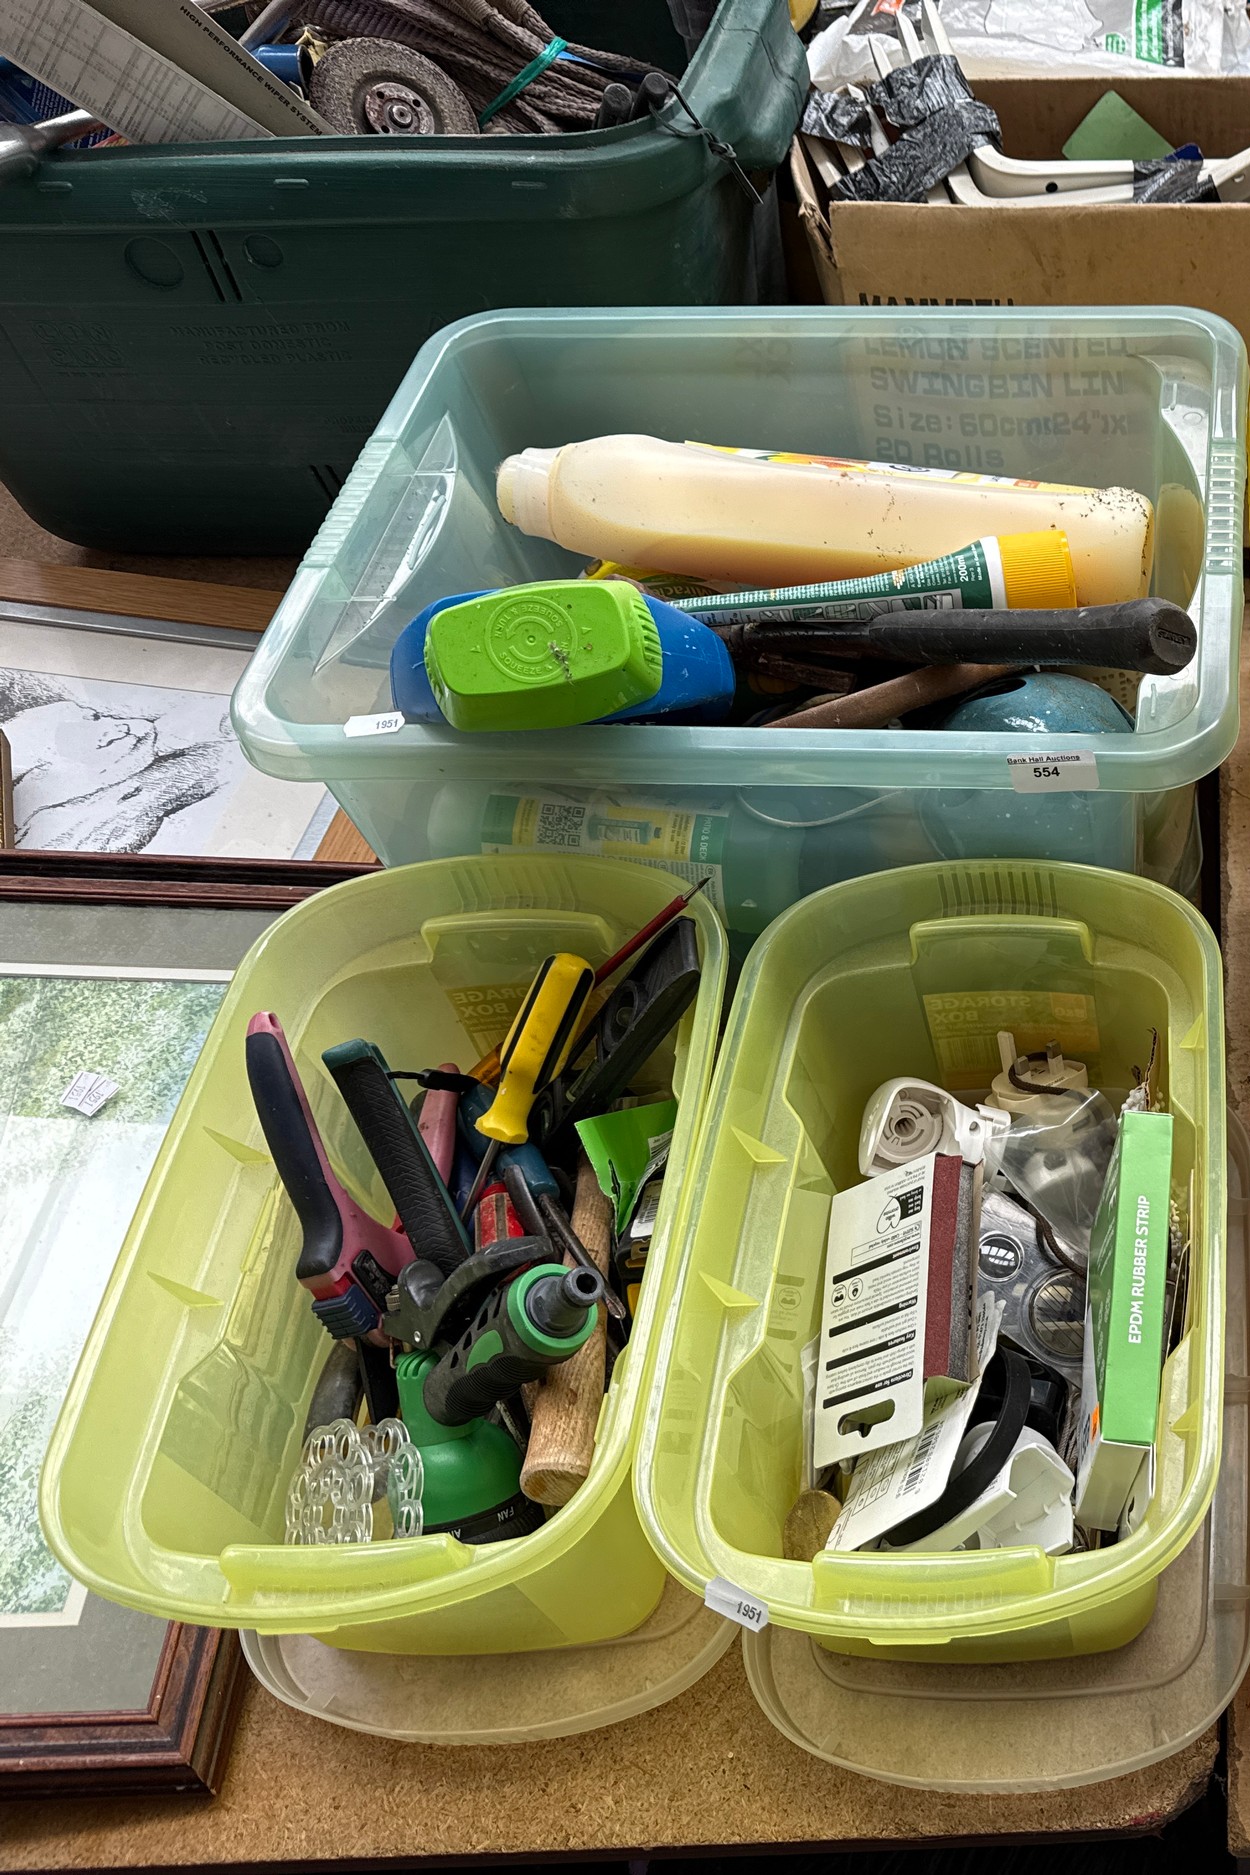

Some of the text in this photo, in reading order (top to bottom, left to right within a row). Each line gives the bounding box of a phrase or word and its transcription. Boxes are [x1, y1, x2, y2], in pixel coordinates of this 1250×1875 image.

[179, 5, 324, 138] HIGH PERFORMANCE WIPER SYSTEM
[169, 320, 350, 337] MANUFACTURED FROM
[203, 336, 333, 352] POST DOMESTIC
[870, 367, 1055, 399] SWINGBIN
[924, 442, 1005, 469] Rolls
[958, 554, 971, 583] 200ml
[494, 614, 512, 639] TURN
[521, 604, 564, 629] SQUEEZE
[499, 650, 543, 675] SQUEEZE
[375, 717, 398, 730] 1951
[1007, 757, 1027, 765] Bank
[1045, 753, 1081, 763] Auctions
[1033, 765, 1061, 779] 554
[1128, 1194, 1150, 1344] EPDM RUBBER STRIP
[898, 1296, 916, 1309] Warning
[890, 1369, 911, 1384] Directions
[496, 1506, 515, 1522] FAN
[736, 1600, 762, 1624] 1951
